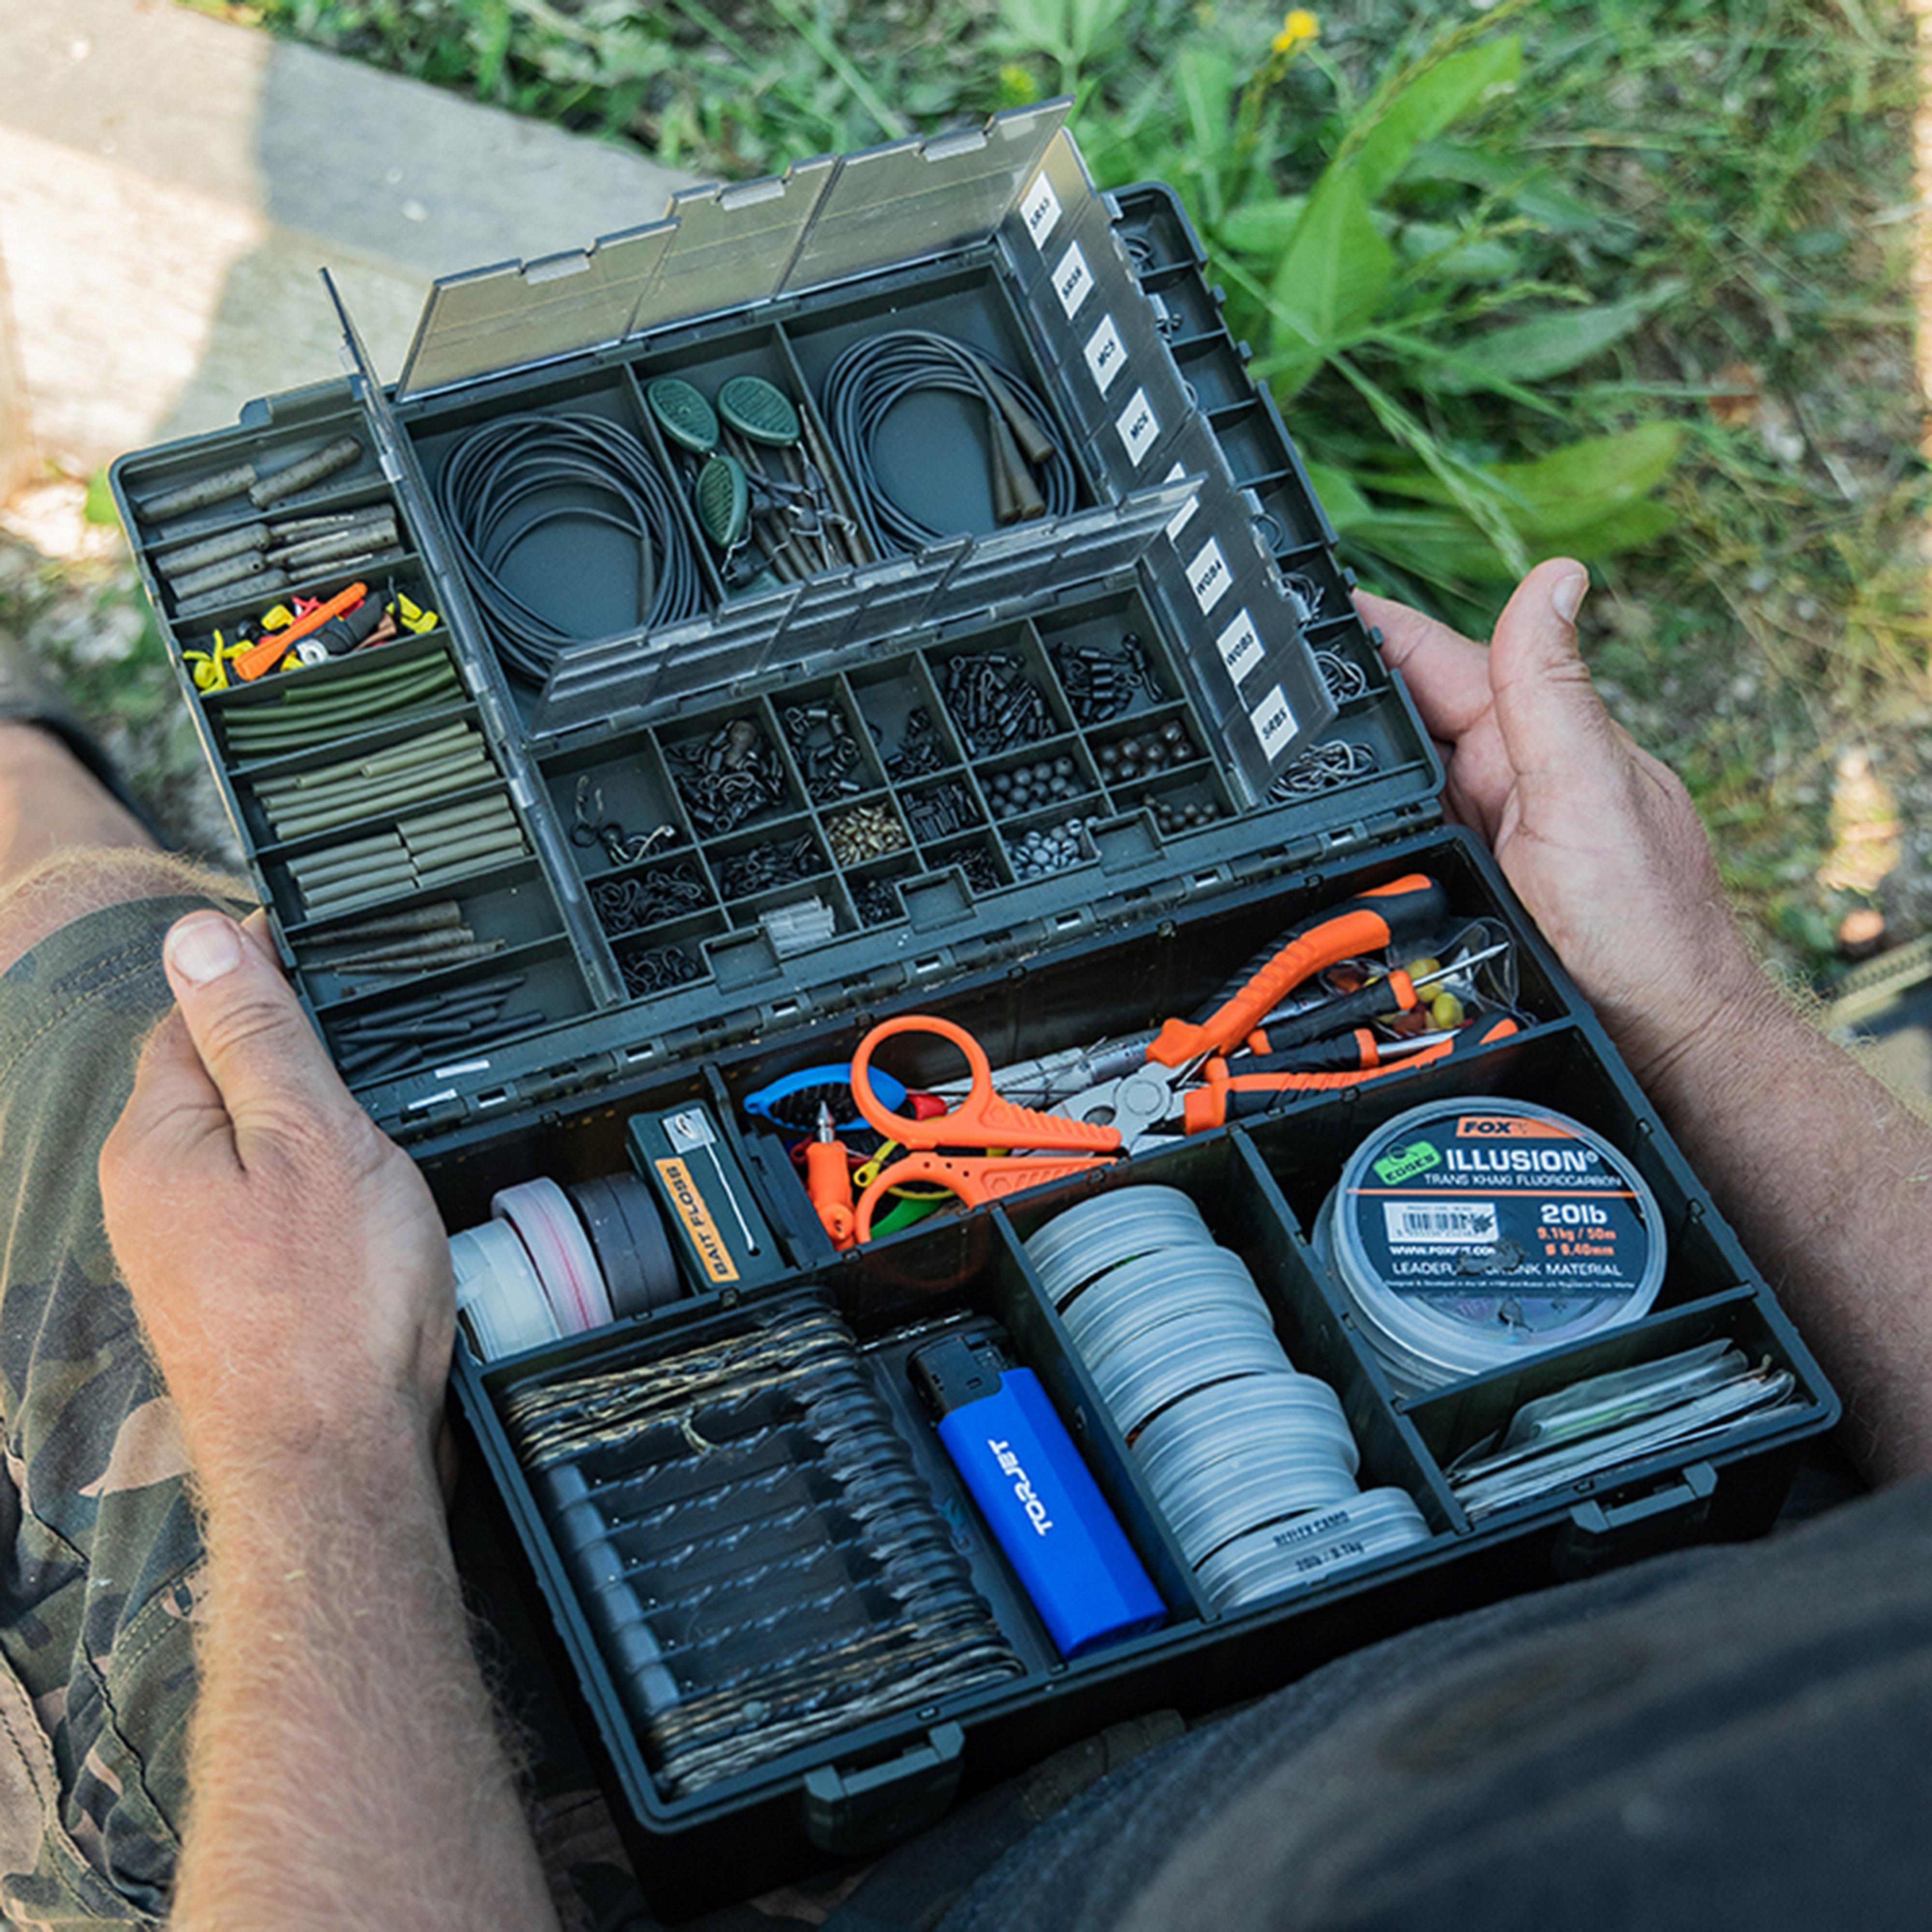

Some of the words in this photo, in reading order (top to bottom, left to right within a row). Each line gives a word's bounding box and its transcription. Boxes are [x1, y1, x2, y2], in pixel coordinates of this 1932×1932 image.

[1464, 1121, 1511, 1134] FOX
[1385, 1153, 1435, 1181] EDGES
[1424, 1174, 1469, 1186] TRANS
[1516, 1174, 1622, 1187] FLUOROCARBON
[667, 1166, 705, 1226] FLOSS
[1541, 1204, 1607, 1224] 20lb
[699, 1234, 728, 1275] BAIT
[1546, 1263, 1622, 1276] MATERIAL
[988, 1439, 1053, 1536] TORJET
